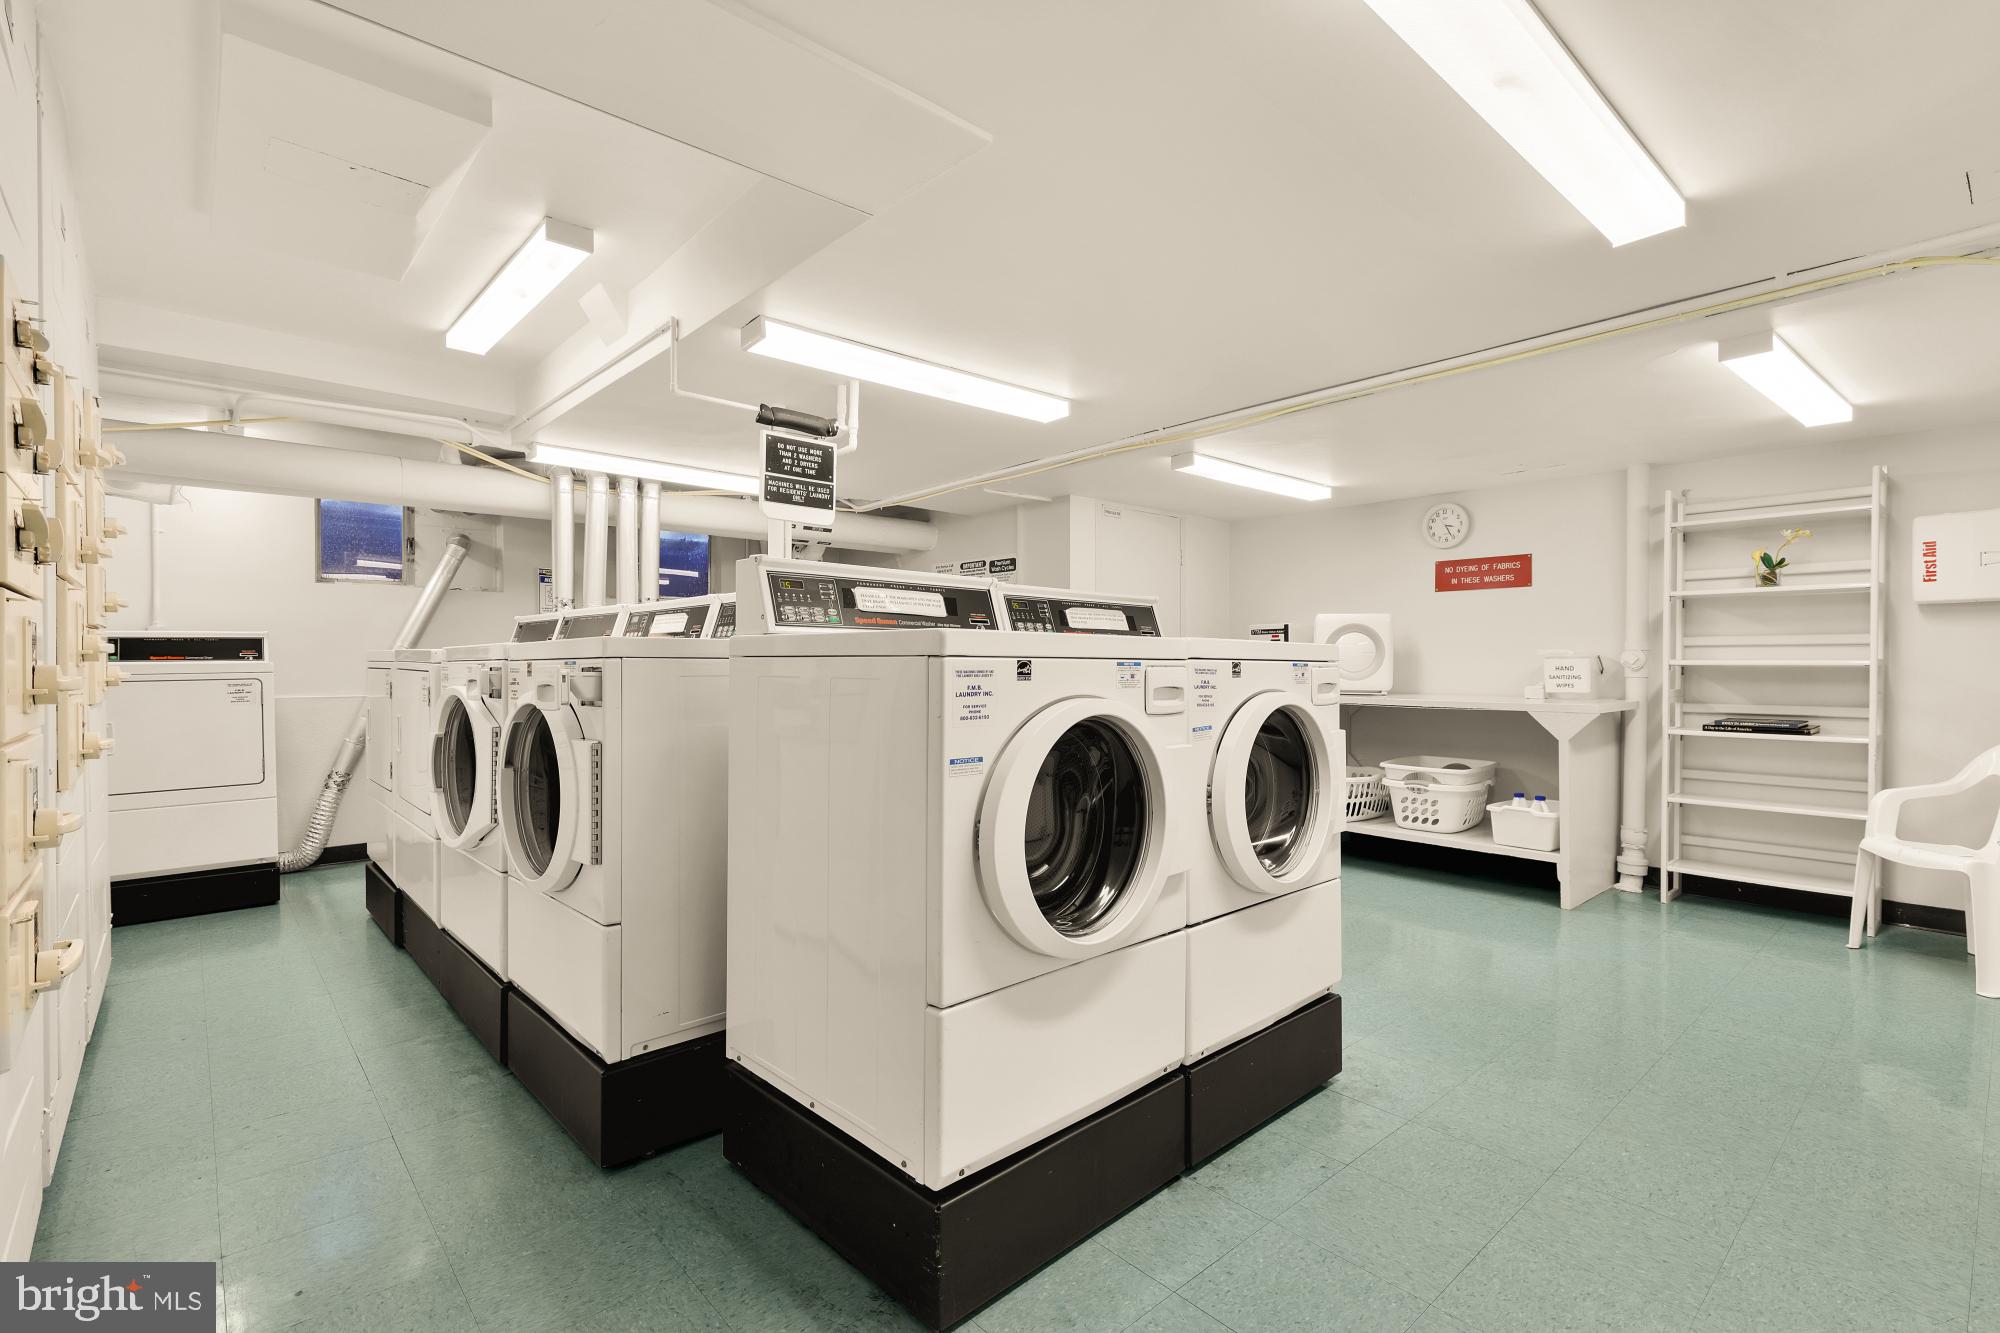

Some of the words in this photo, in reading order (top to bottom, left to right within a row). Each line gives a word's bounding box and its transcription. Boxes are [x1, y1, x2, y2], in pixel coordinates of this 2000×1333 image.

[799, 454, 822, 462] WASHERS
[800, 460, 818, 468] DRYERS
[768, 480, 794, 488] MACHINES
[1922, 541, 1937, 557] Aid
[1456, 565, 1479, 573] DYEING
[1493, 562, 1520, 570] FABRICS
[1922, 559, 1937, 582] First
